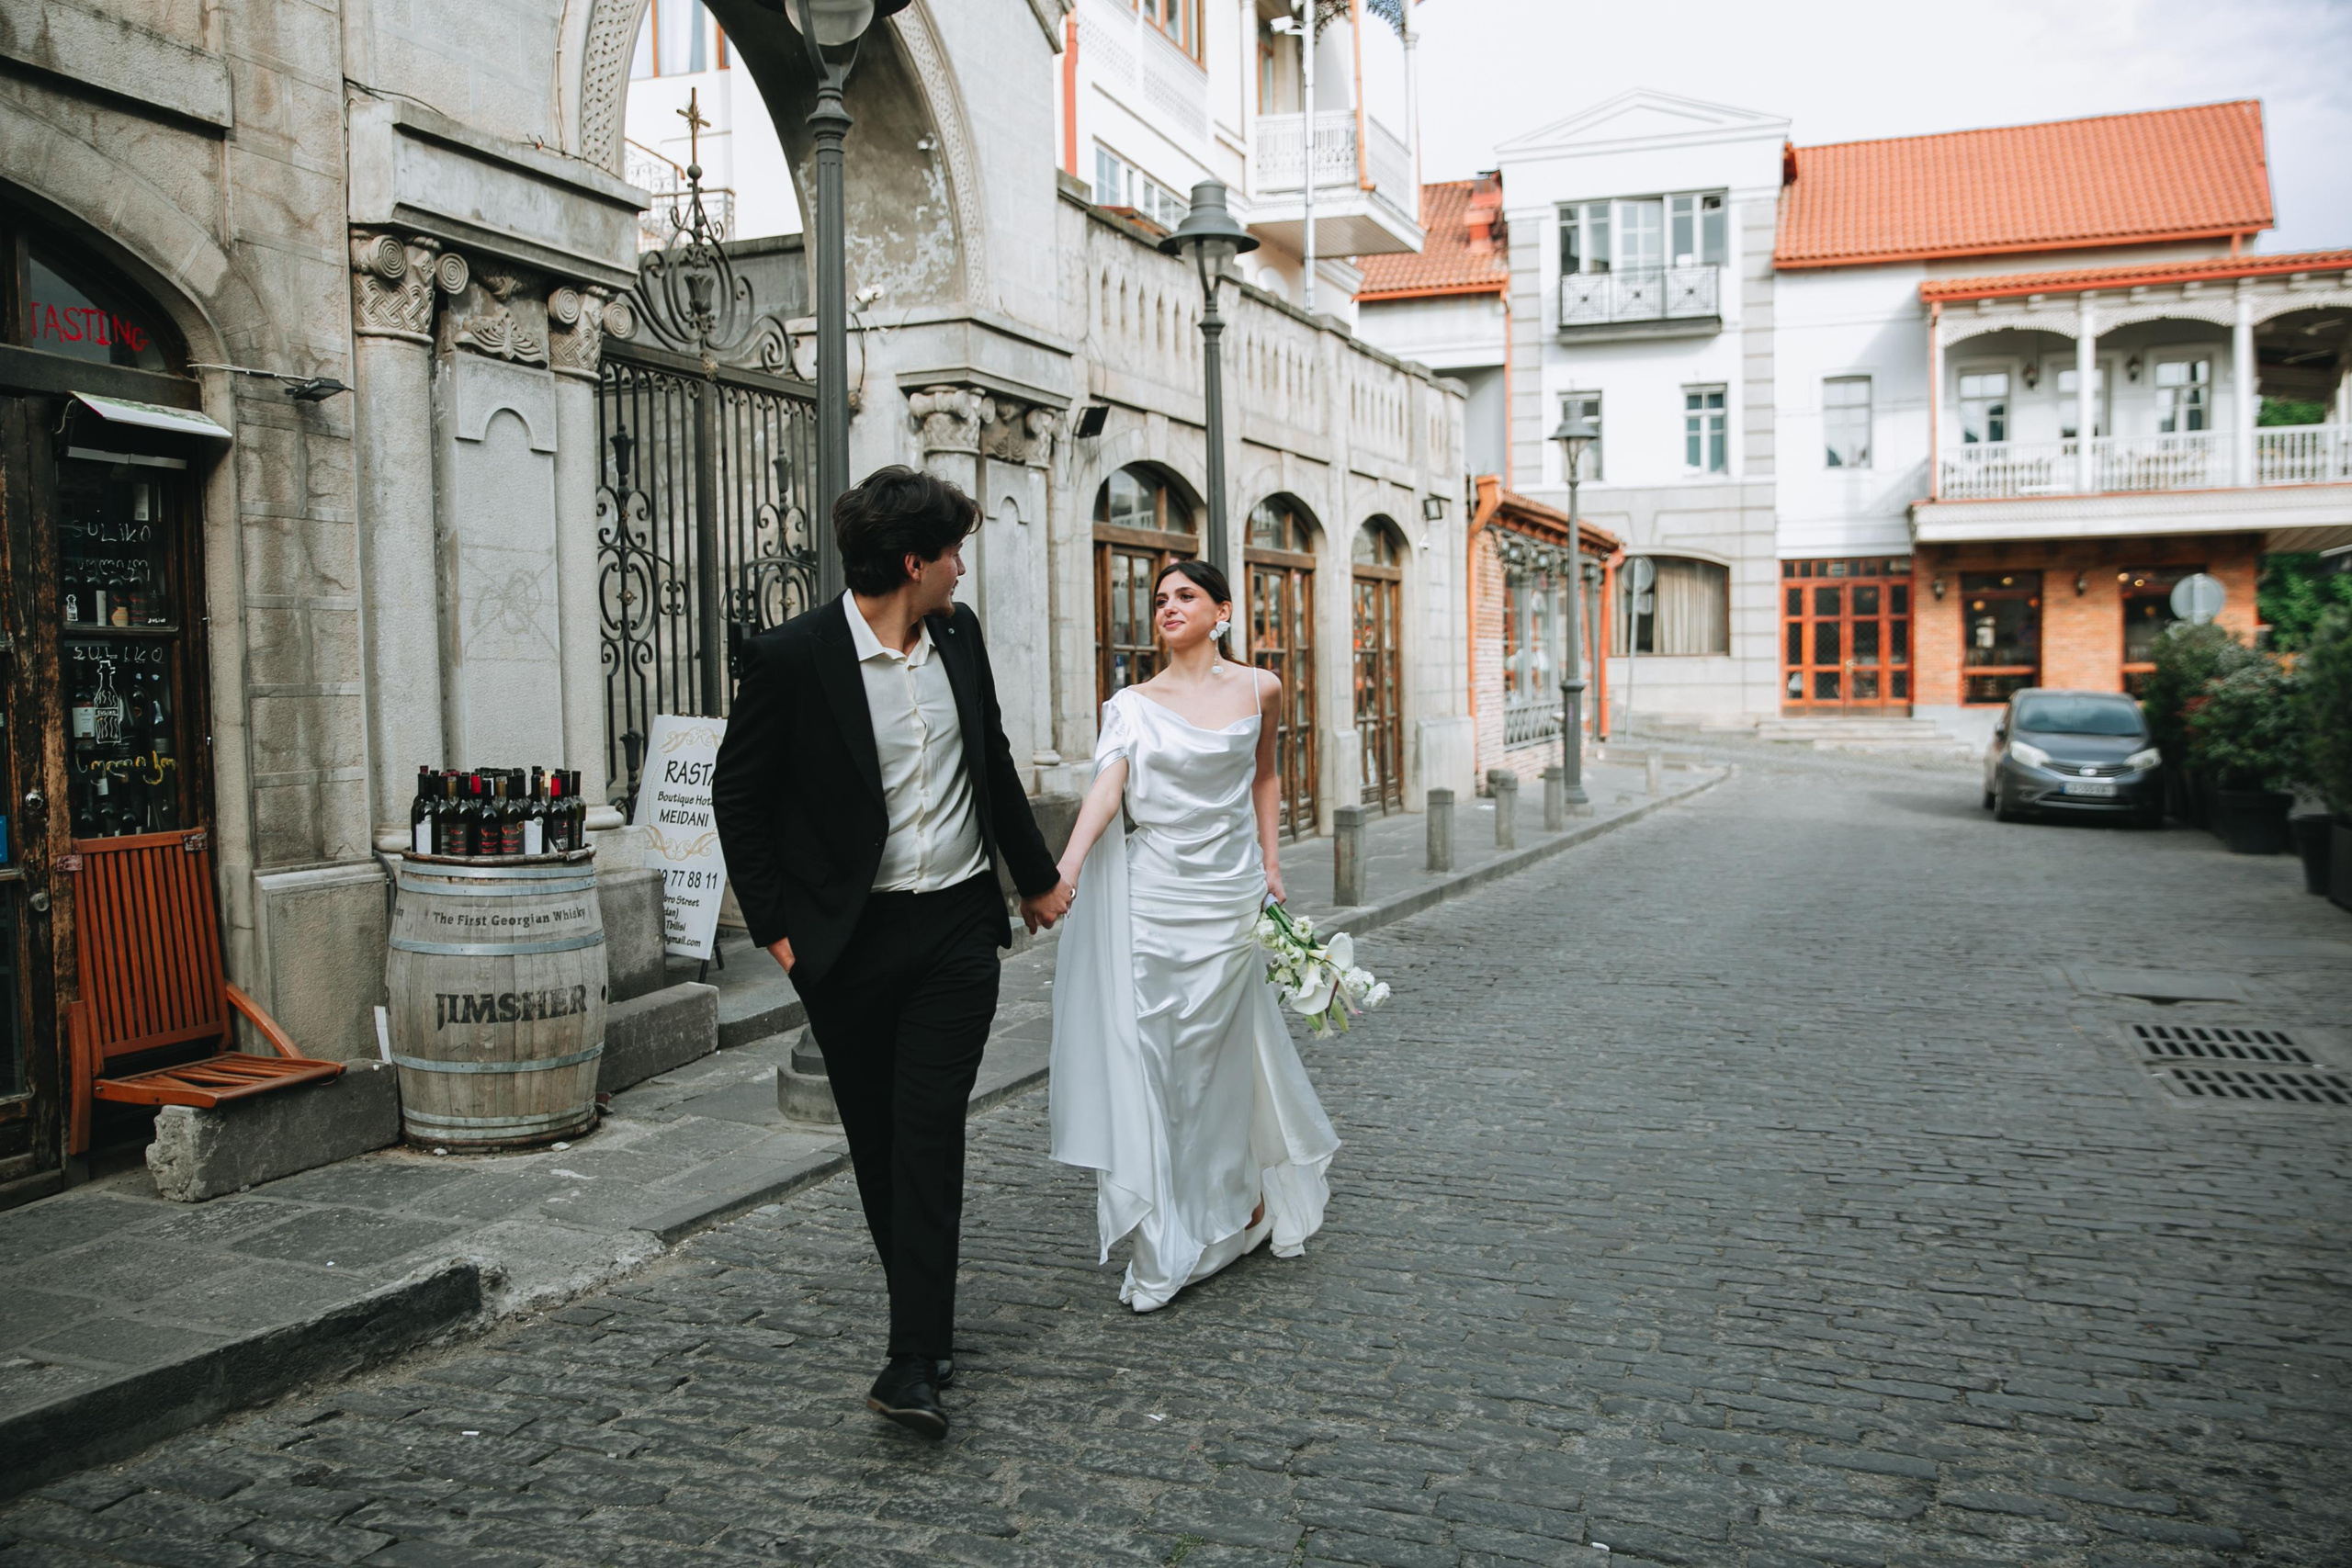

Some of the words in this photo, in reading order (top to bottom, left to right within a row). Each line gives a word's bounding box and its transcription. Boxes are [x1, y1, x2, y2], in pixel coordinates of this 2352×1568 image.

[30, 301, 150, 352] TASTING
[657, 790, 695, 807] Boutique
[695, 794, 713, 807] Hot
[659, 808, 709, 827] MEIDANI
[671, 869, 685, 886] 77
[687, 871, 702, 888] 88
[706, 872, 718, 890] 11
[676, 895, 700, 908] Street
[433, 911, 454, 925] The
[457, 914, 487, 926] First
[491, 912, 550, 929] Georgian
[552, 907, 585, 920] Whisky
[663, 907, 679, 919] dan)
[435, 984, 588, 1031] JIMSHER
